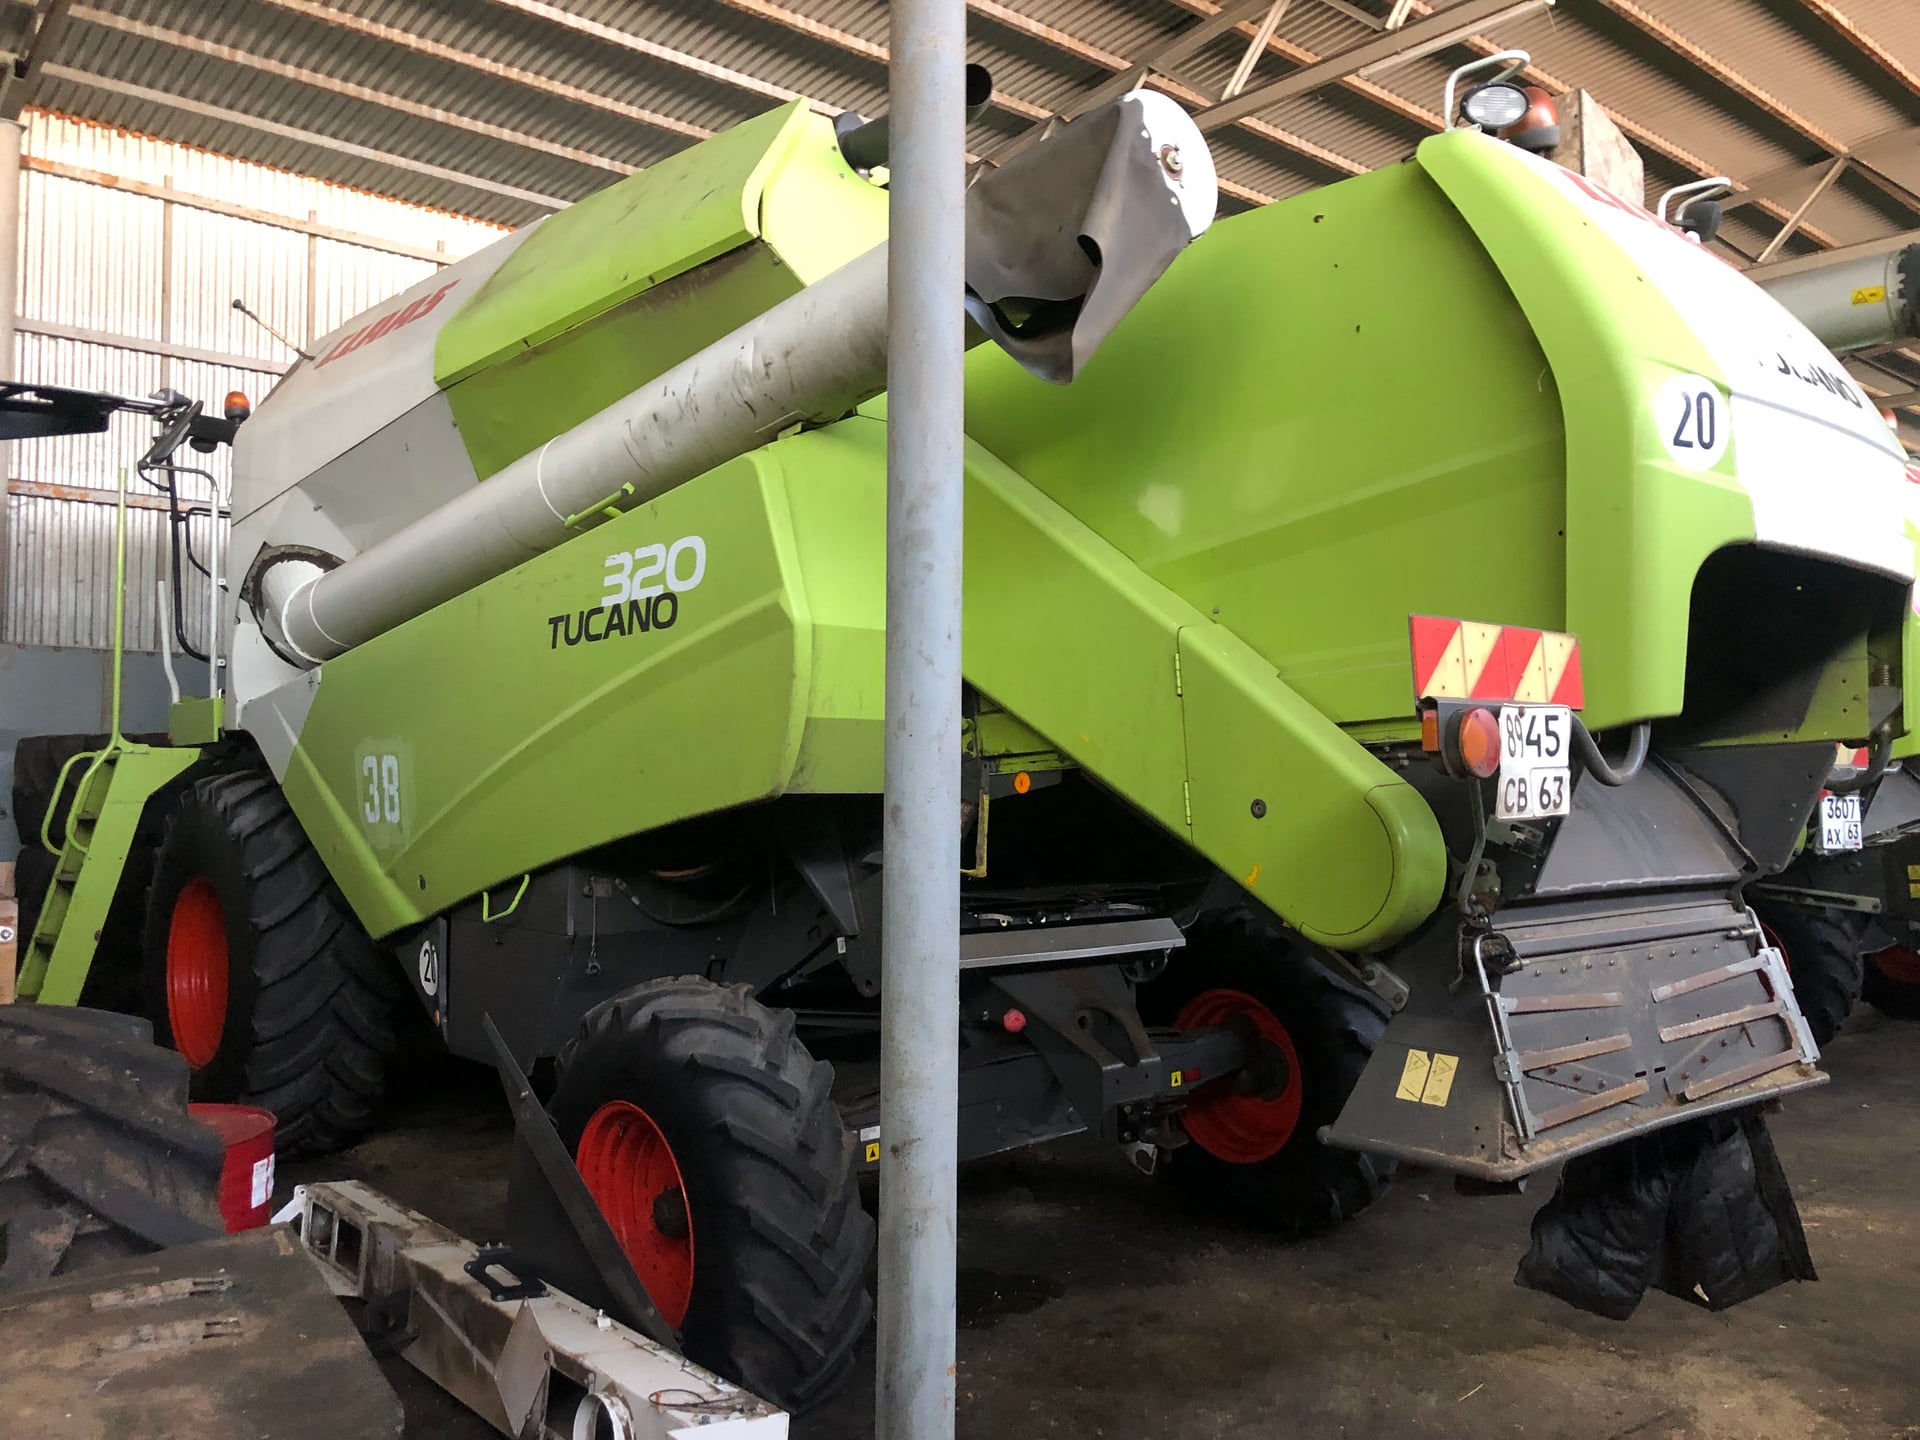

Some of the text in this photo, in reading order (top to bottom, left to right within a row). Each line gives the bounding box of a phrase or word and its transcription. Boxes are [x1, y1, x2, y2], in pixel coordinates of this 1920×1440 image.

[1673, 391, 1715, 450] 20
[601, 535, 707, 607] 320
[548, 592, 678, 650] TUCANO
[1506, 713, 1560, 758] 8945
[362, 754, 401, 824] 38
[1539, 775, 1564, 810] 63
[1826, 798, 1856, 819] 3607
[1847, 823, 1859, 840] 63
